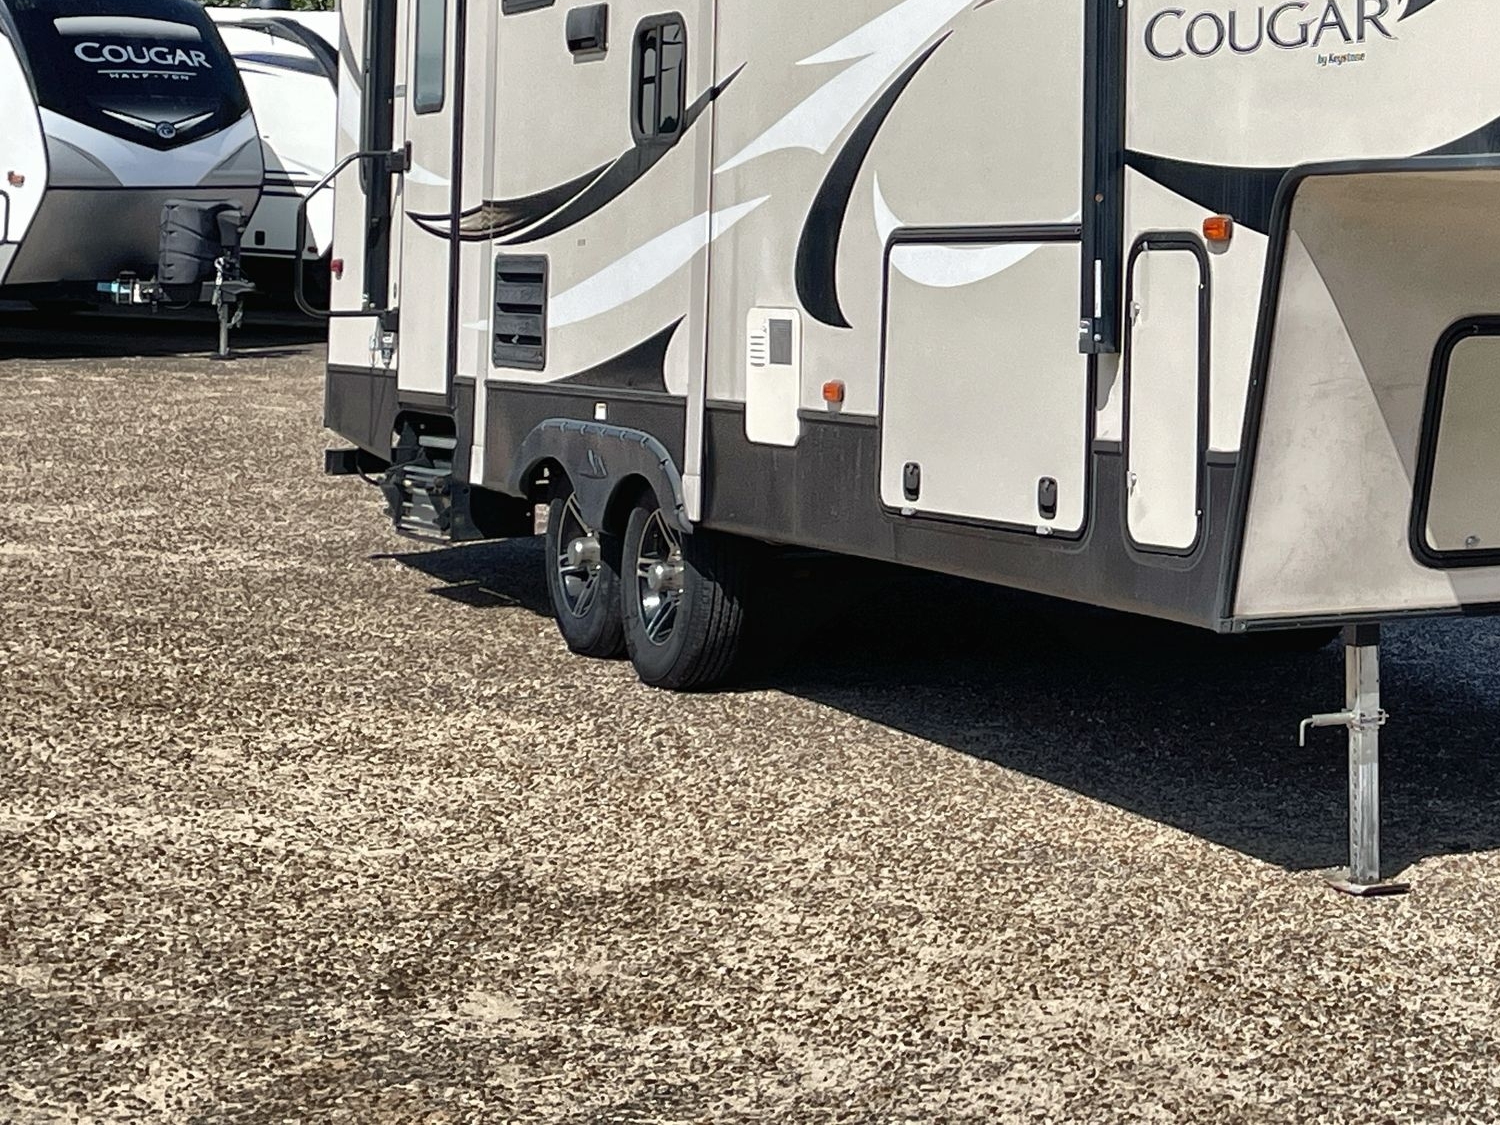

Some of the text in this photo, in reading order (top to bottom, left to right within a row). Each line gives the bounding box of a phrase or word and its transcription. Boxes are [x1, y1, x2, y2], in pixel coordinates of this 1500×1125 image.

[74, 41, 213, 69] COUGAR
[1317, 52, 1366, 67] by Keystone
